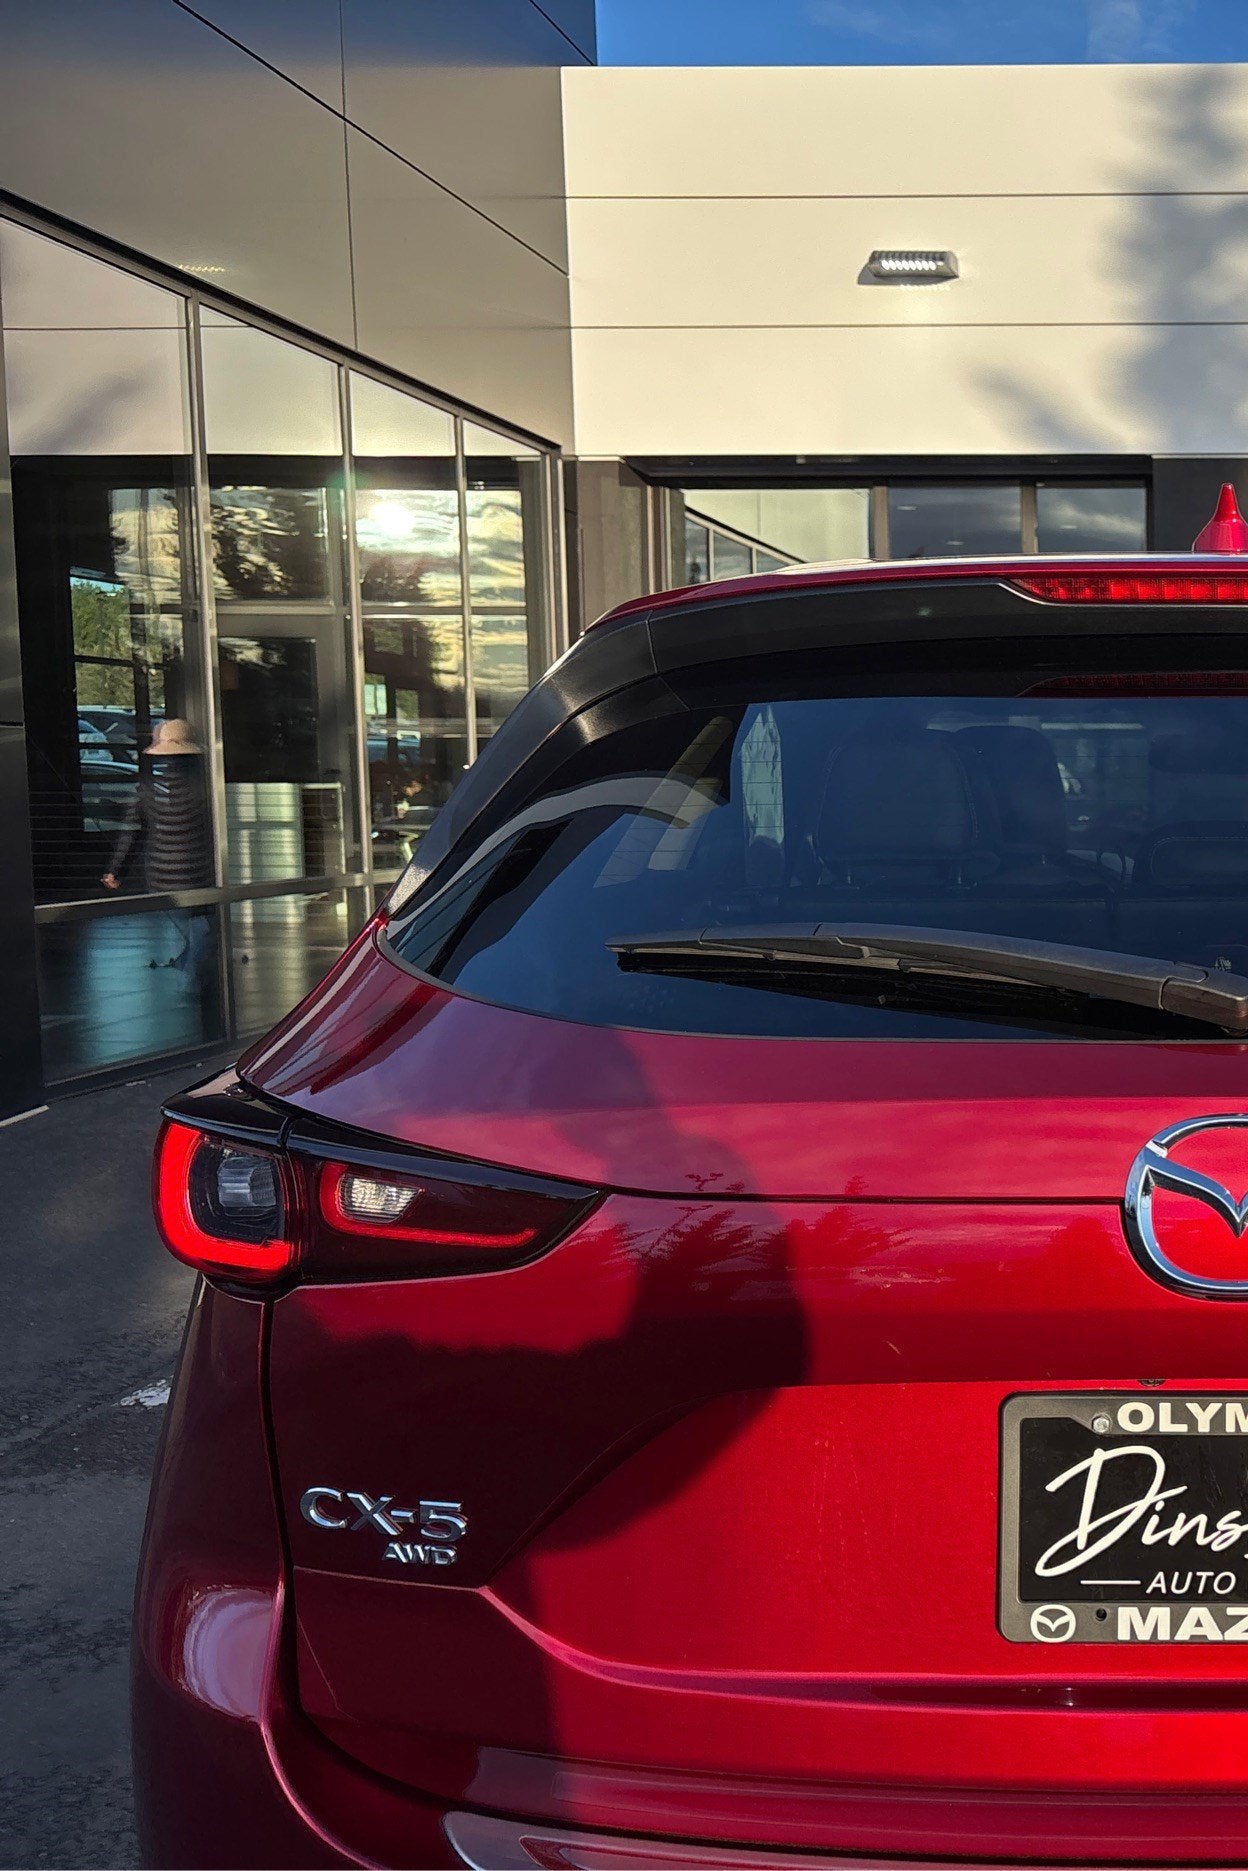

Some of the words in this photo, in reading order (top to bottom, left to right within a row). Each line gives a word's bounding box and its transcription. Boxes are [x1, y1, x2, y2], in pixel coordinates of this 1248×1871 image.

[300, 1486, 467, 1541] CX-5
[382, 1543, 458, 1565] AWD
[1146, 1572, 1236, 1595] AUTO
